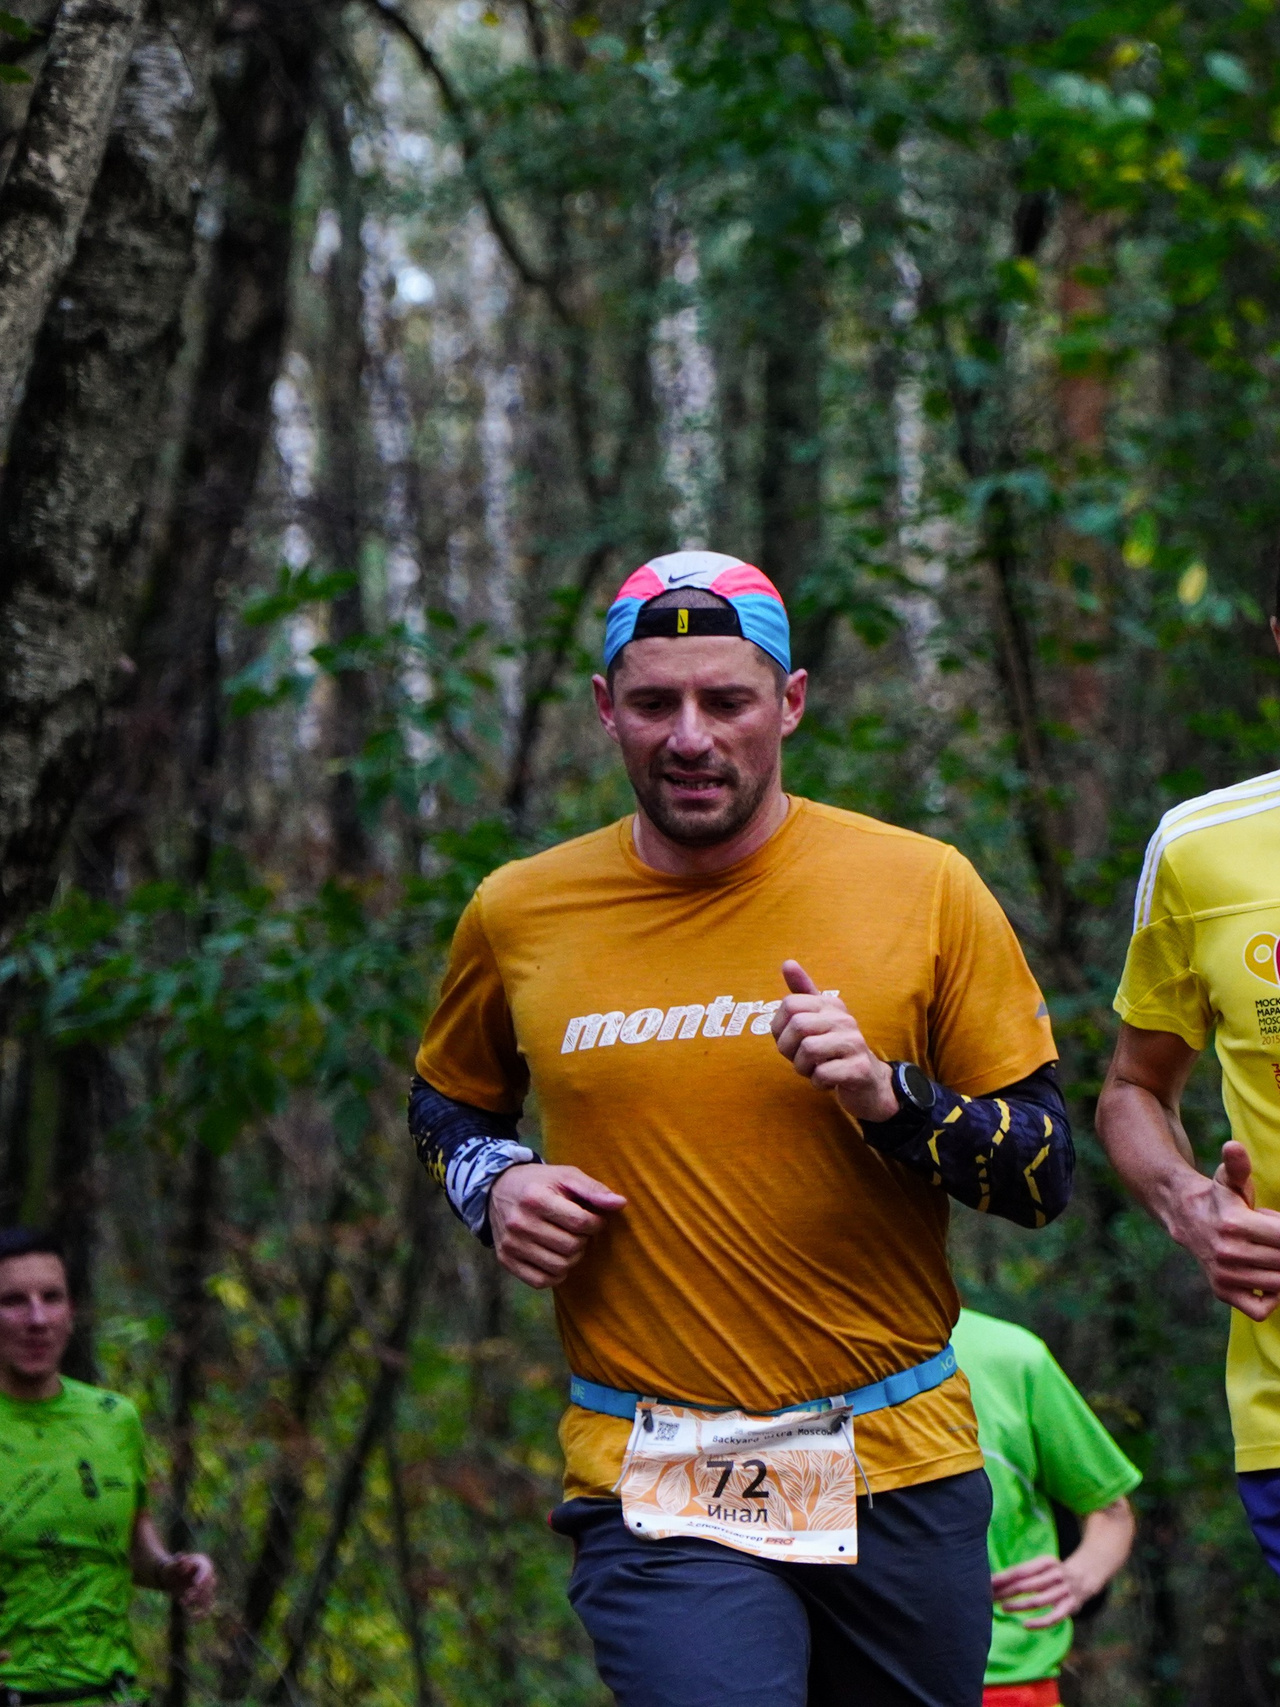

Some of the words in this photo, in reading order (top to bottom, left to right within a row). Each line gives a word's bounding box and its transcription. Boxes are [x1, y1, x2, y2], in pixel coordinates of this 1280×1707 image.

[1262, 1035, 1280, 1045] 2015
[706, 1458, 769, 1499] 72
[707, 1504, 768, 1523] Инал
